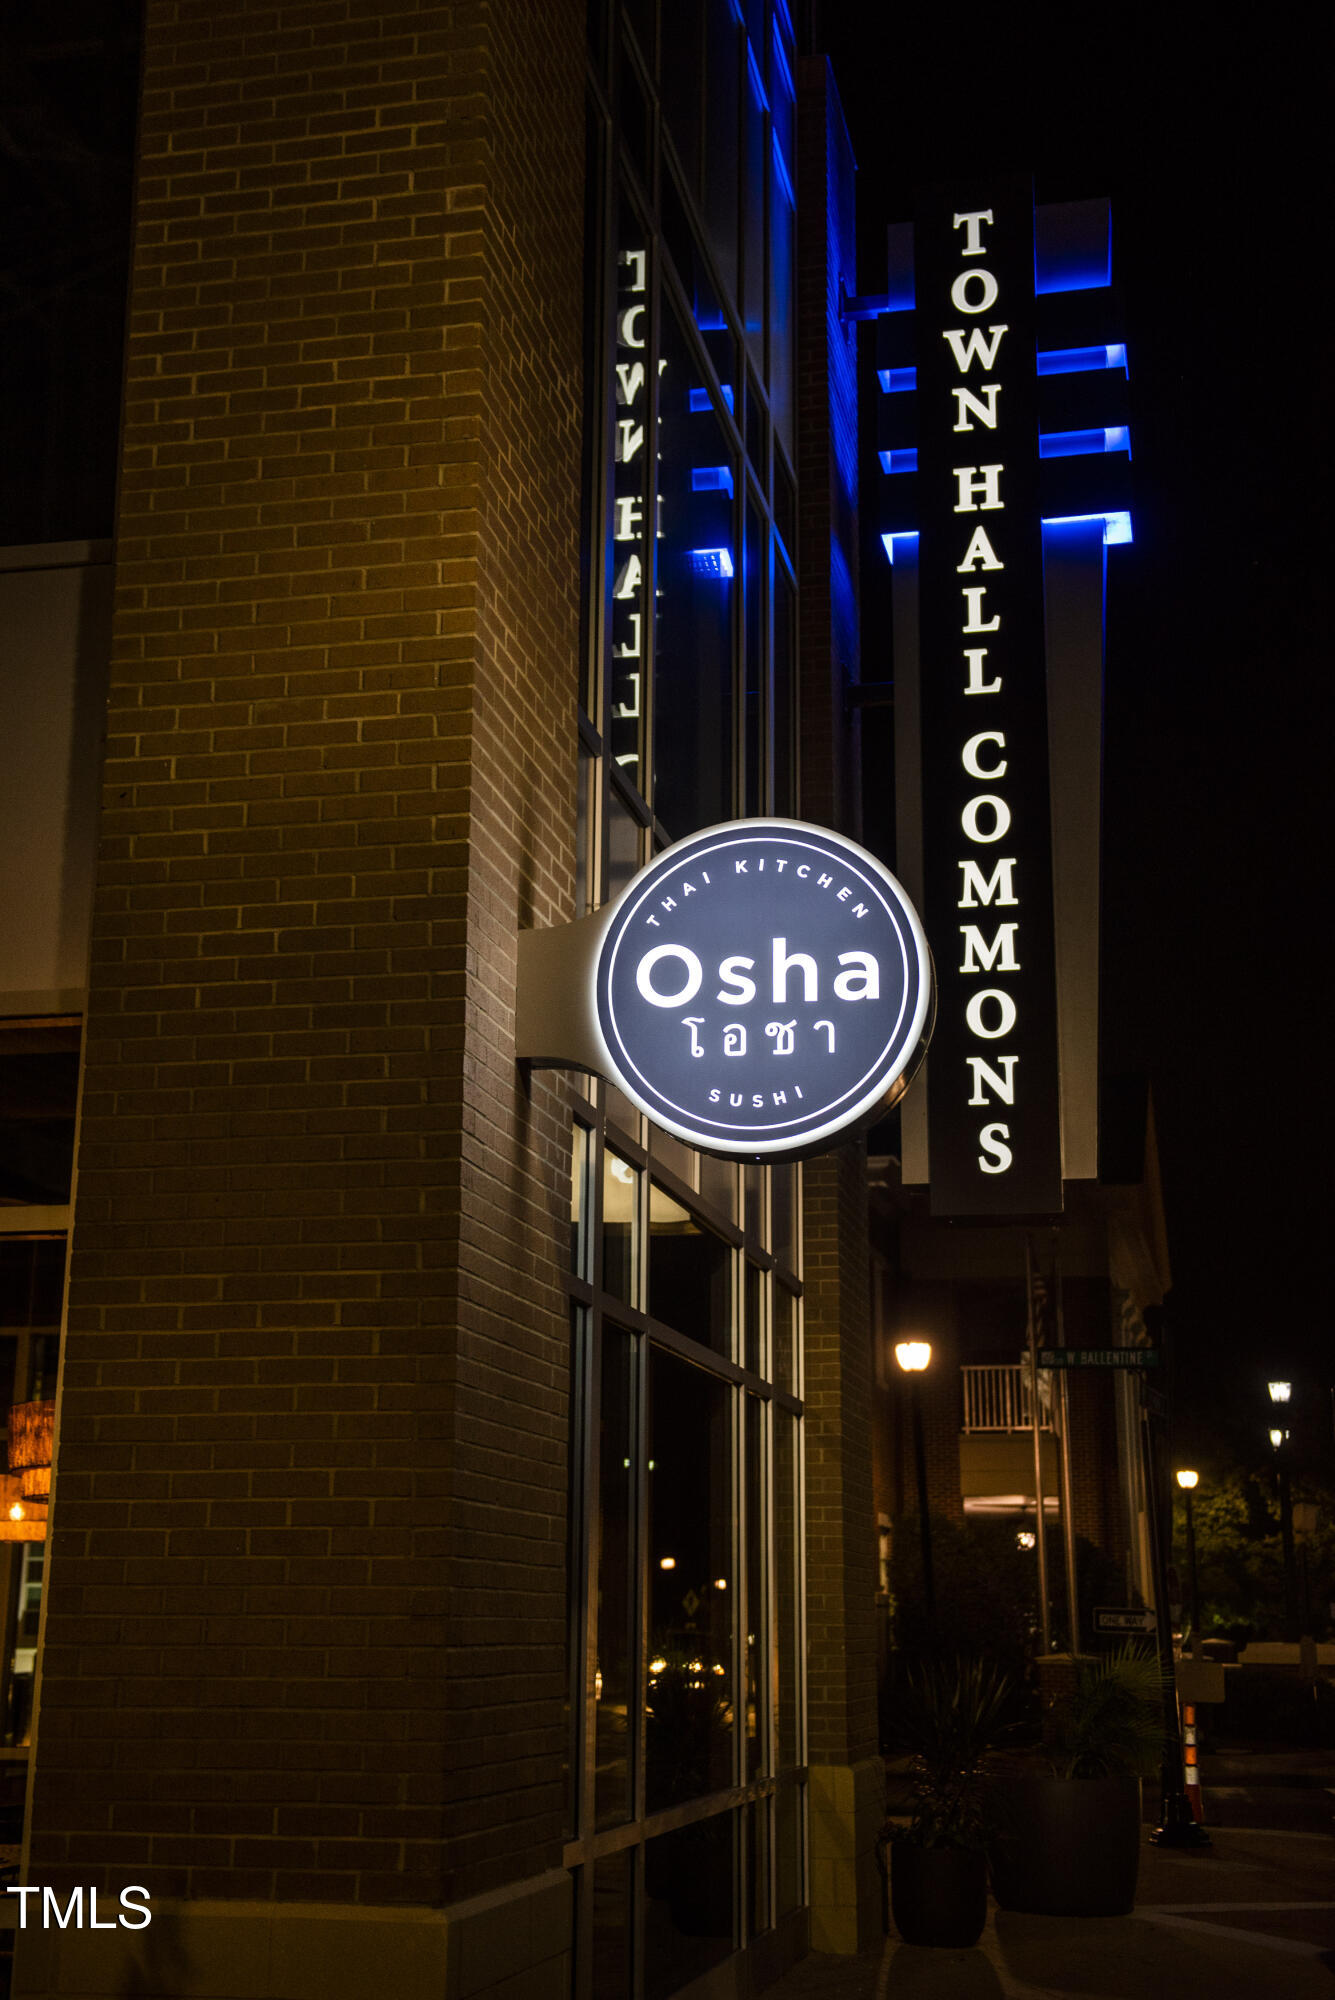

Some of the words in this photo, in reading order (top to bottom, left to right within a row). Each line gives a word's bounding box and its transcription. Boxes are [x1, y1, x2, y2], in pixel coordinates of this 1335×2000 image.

[942, 208, 1009, 432] TOWN
[952, 463, 1005, 695] HALL
[646, 871, 711, 928] THAI
[735, 858, 869, 918] KITCHEN
[636, 937, 880, 1008] Osha
[957, 731, 1022, 1174] COMMONS
[681, 1016, 836, 1058] โอชา
[708, 1085, 803, 1108] SUSHI
[1080, 1351, 1143, 1365] BALLENTINE
[1124, 1615, 1143, 1625] WAY
